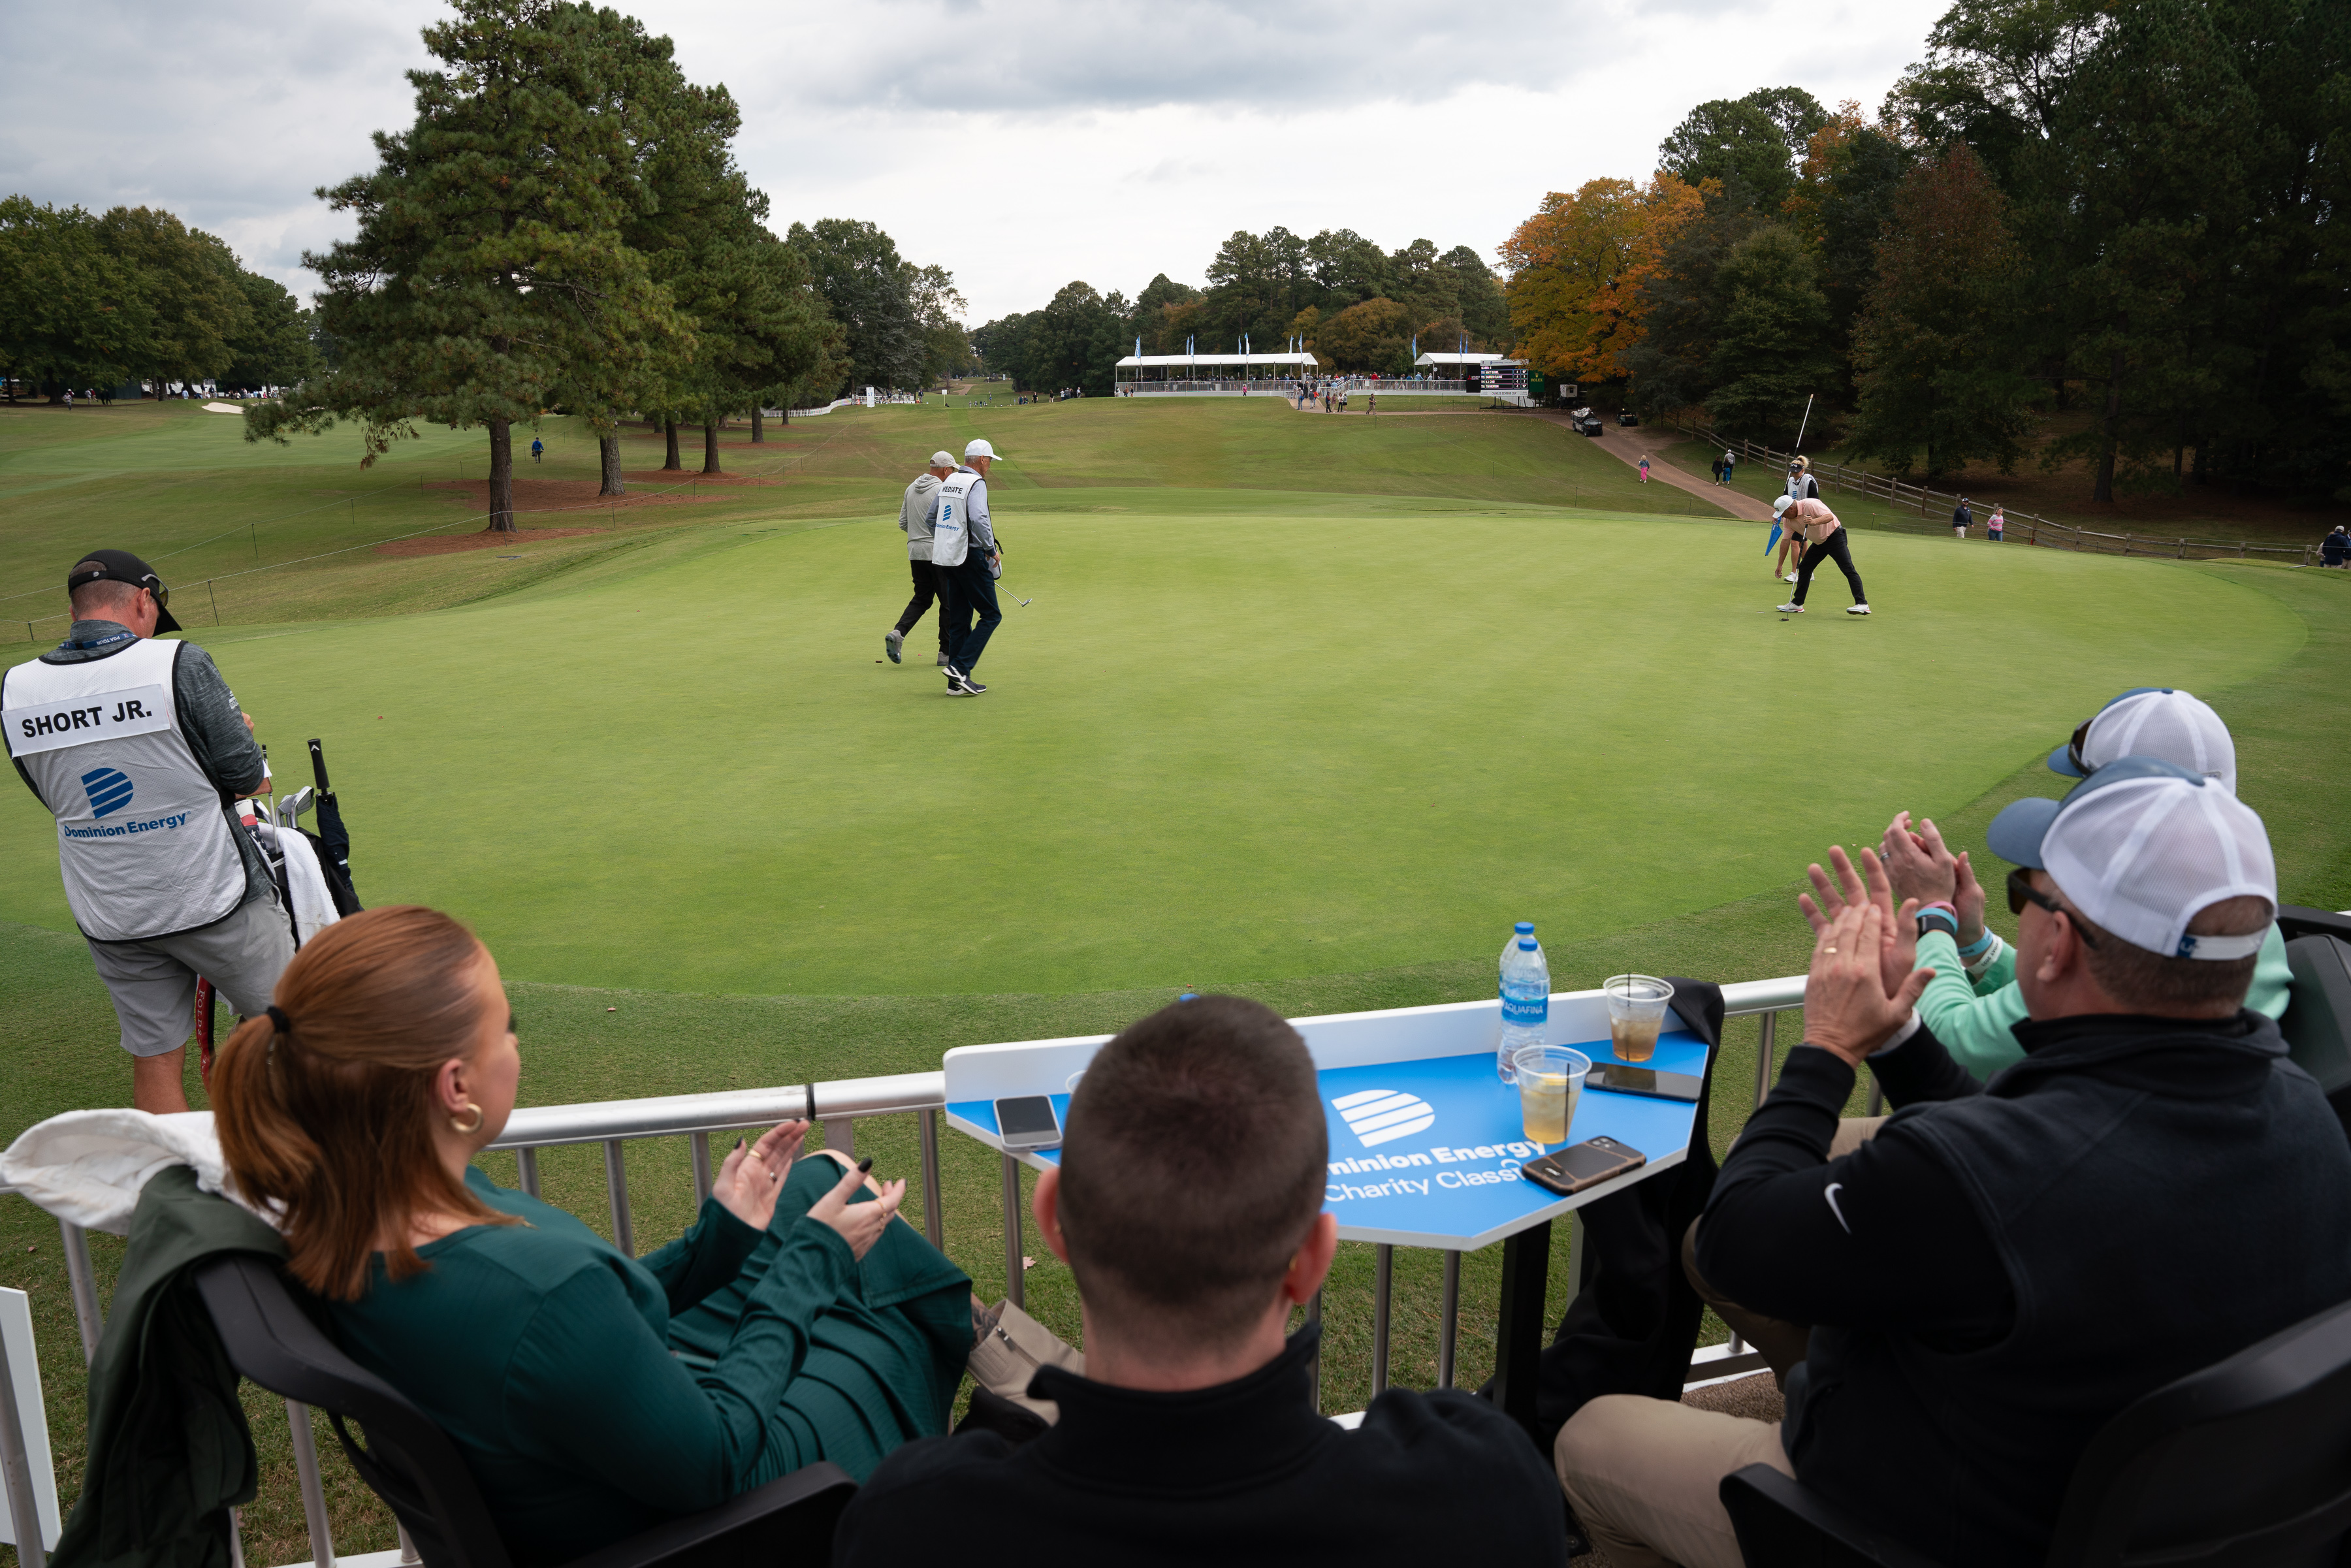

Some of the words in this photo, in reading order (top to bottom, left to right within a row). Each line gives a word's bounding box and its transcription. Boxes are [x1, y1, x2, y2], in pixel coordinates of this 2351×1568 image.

[22, 705, 103, 738] SHORT
[112, 699, 152, 722] JR.
[64, 824, 126, 839] Dominion
[1504, 1002, 1543, 1015] AQUAFINA
[1326, 1154, 1432, 1175] minion
[1430, 1140, 1546, 1163] Energy
[1325, 1178, 1429, 1202] Charity
[1436, 1159, 1526, 1189] Classi
